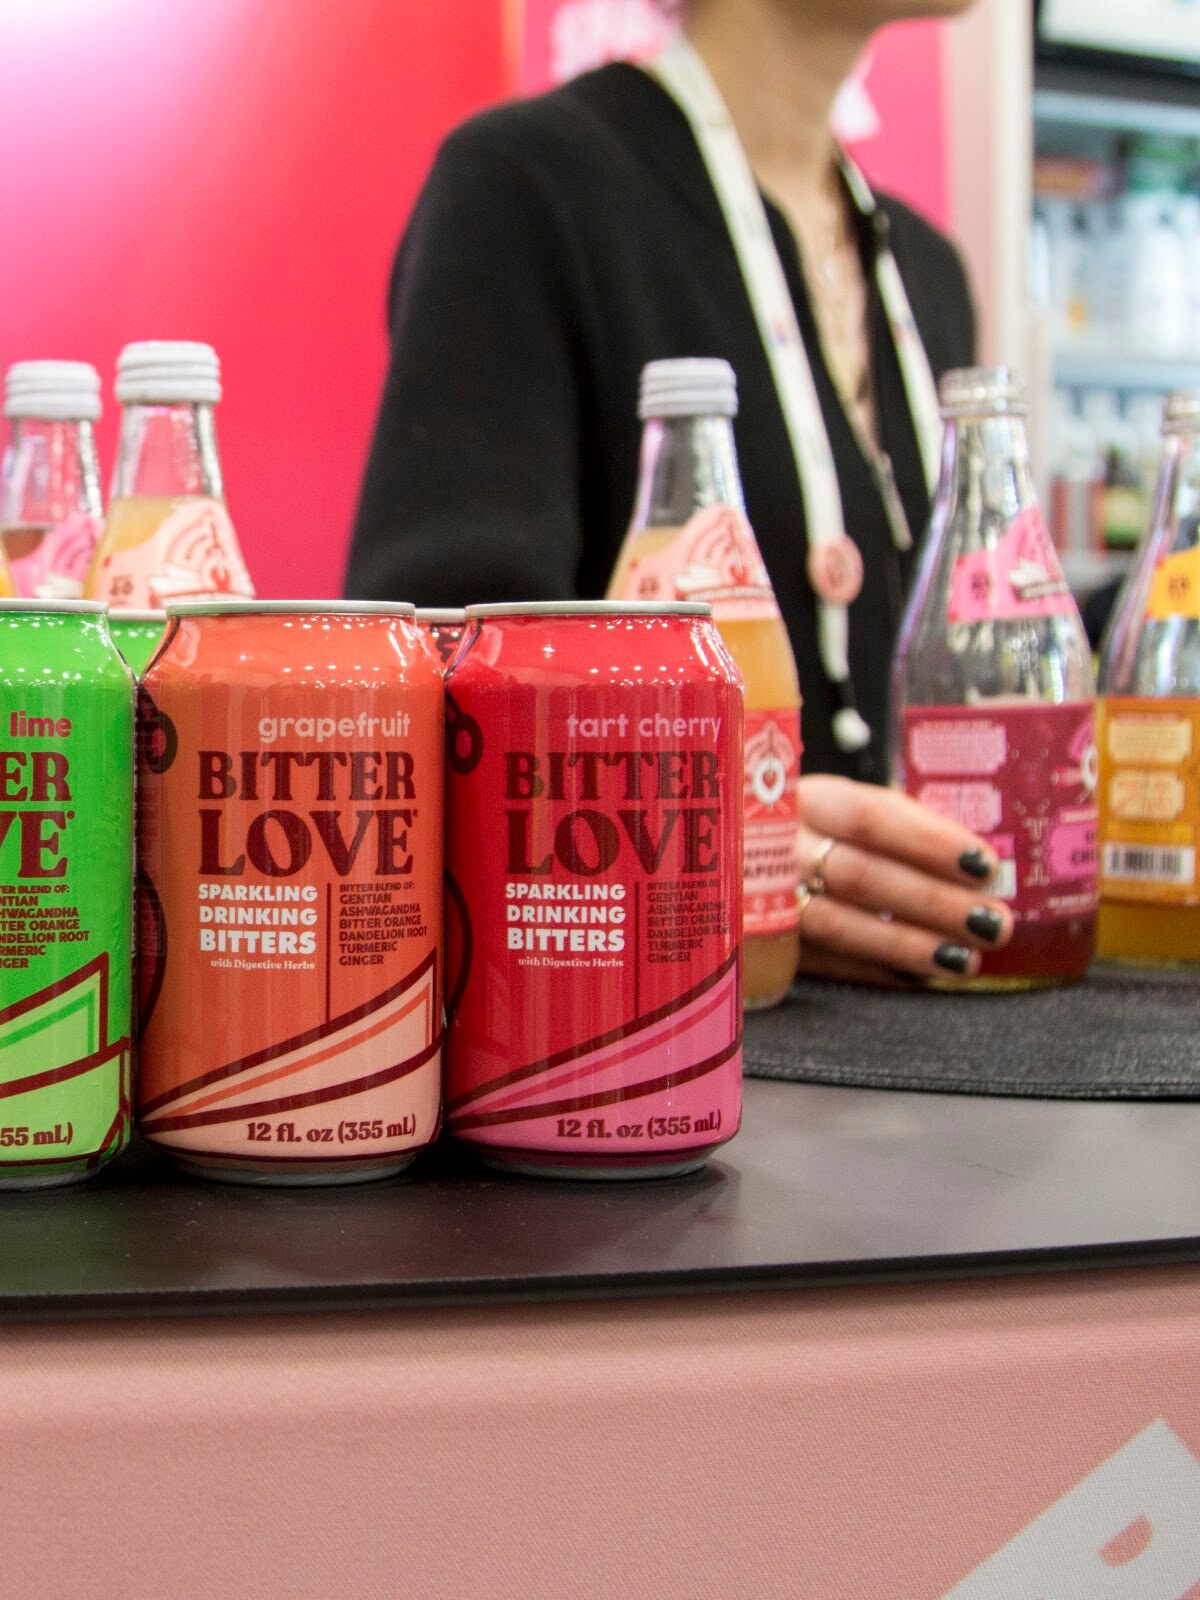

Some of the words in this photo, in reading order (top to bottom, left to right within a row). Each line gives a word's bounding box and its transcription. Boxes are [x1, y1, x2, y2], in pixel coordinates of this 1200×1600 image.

[10, 710, 71, 738] lime
[258, 710, 410, 744] grapefruit
[568, 714, 628, 738] tart
[638, 713, 721, 742] cherry
[198, 751, 416, 800] BITTER
[506, 752, 720, 800] BITTER
[18, 885, 51, 893] BLEND
[199, 884, 318, 902] SPARKLING
[340, 883, 373, 892] BITTER
[375, 883, 401, 891] BLEND
[506, 883, 626, 900] SPARKLING
[340, 893, 391, 905] GENTIAN
[200, 906, 318, 925] DRINKING
[340, 904, 421, 916] ASHWAGANDHA
[507, 905, 626, 924] DRINKING
[29, 919, 79, 930] ORANGE
[340, 918, 381, 929] BITTER
[384, 915, 421, 927] ORANGE
[59, 931, 90, 942] ROOT
[200, 929, 316, 954] BITTERS
[339, 929, 404, 942] DANDELION
[407, 926, 427, 937] ROOT
[507, 927, 625, 952] BITTERS
[340, 941, 397, 954] TURMERIC
[211, 959, 232, 968] with
[234, 960, 282, 971] Digestive
[284, 960, 314, 970] Herbs
[339, 955, 384, 965] GINGER
[518, 957, 540, 966] with
[542, 957, 591, 968] Digestive
[593, 957, 624, 967] Herbs
[247, 1121, 271, 1141] 12
[277, 1122, 302, 1143] fl.
[306, 1127, 334, 1143] oz
[338, 1121, 383, 1143] (355
[386, 1115, 416, 1140] mL)
[556, 1119, 581, 1138] 12
[586, 1119, 612, 1138] fl.
[616, 1123, 643, 1137] oz
[647, 1115, 691, 1139] (355
[694, 1109, 722, 1133] mL)
[33, 1124, 73, 1145] mL)
